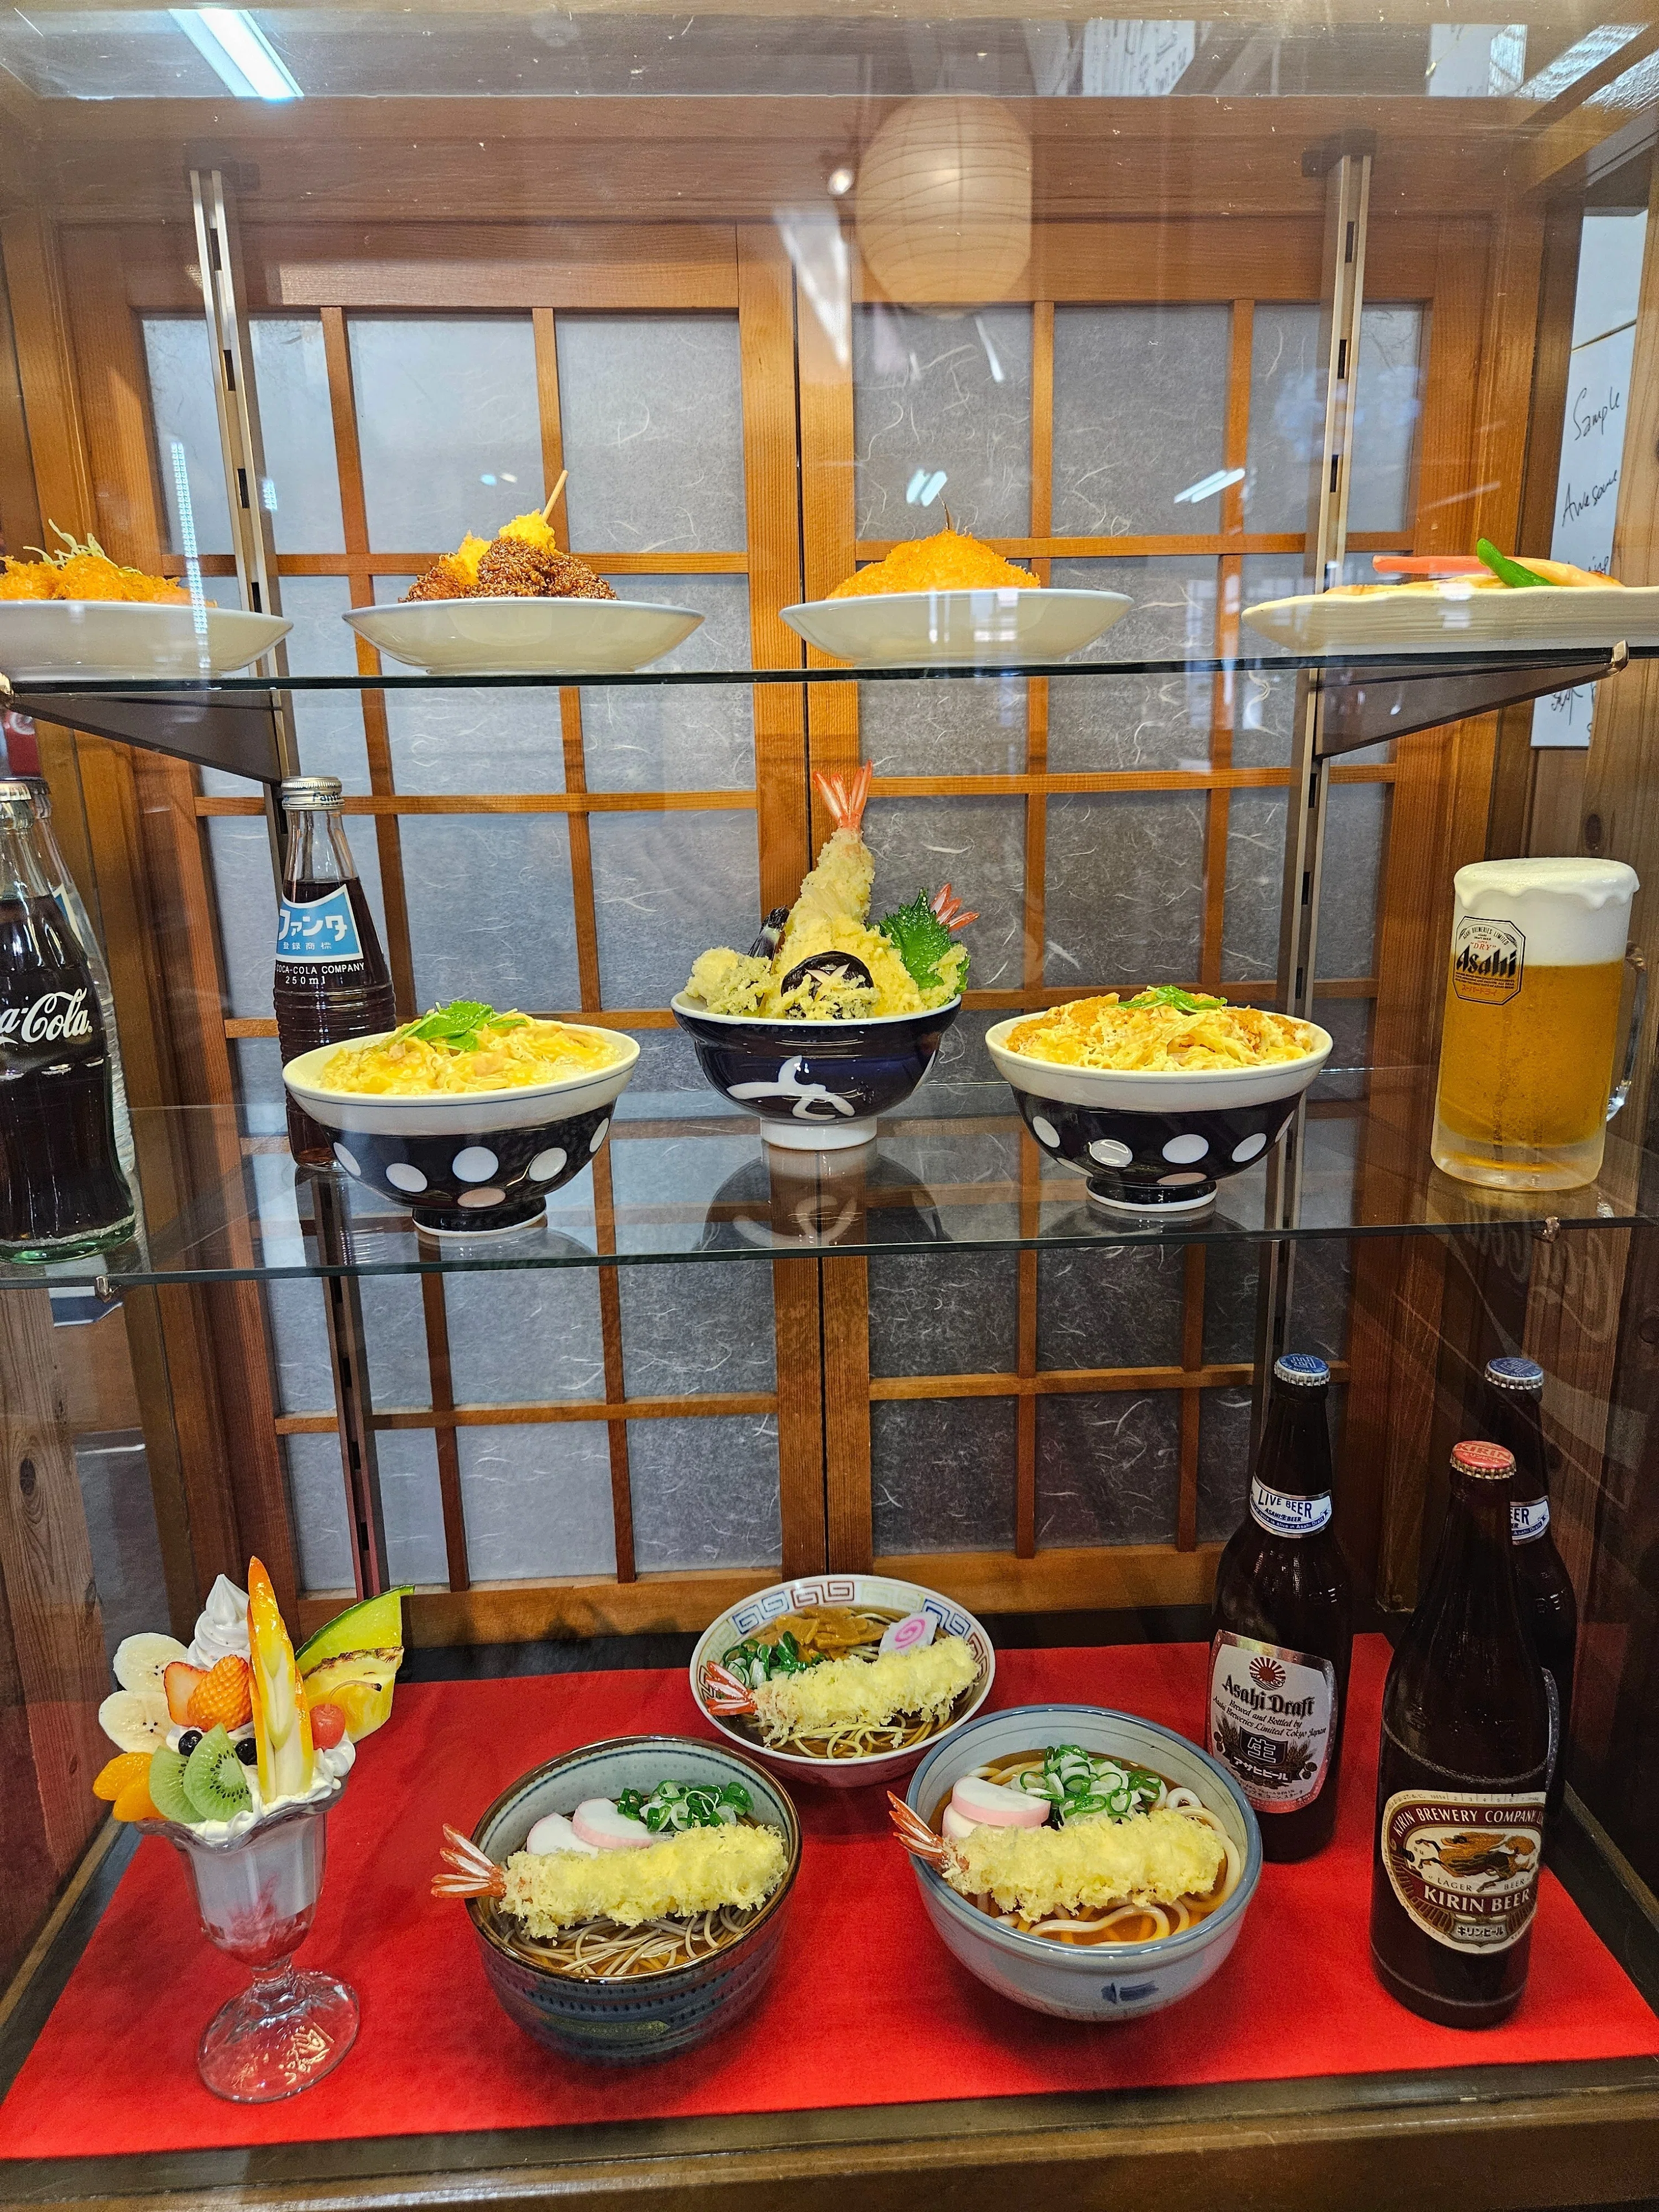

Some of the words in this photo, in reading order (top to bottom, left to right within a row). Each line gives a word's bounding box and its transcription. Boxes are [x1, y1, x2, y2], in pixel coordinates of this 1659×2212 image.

[278, 908, 348, 942] ファンタ
[1494, 931, 1509, 946] LIMITED
[283, 942, 332, 951] 登録商標
[321, 962, 365, 974] COMPANY
[1456, 945, 1517, 978] Asahi
[0, 987, 88, 1045] a-Cola
[1455, 1443, 1511, 1460] KIRIN
[1258, 1489, 1282, 1506] LIVE
[1285, 1500, 1312, 1519] BEER
[1222, 1674, 1266, 1710] Asahi
[1266, 1694, 1316, 1719] Draft
[1213, 1695, 1227, 1712] Asahi
[1226, 1707, 1254, 1728] Breweries
[1254, 1723, 1285, 1736] Limited
[1286, 1729, 1307, 1739] Tokyo
[1307, 1727, 1326, 1738] Japan
[1229, 1699, 1251, 1717] Brewed
[1253, 1713, 1266, 1723] and
[1267, 1716, 1293, 1729] Bottled
[1293, 1720, 1302, 1730] by
[1247, 1737, 1276, 1764] 生
[1233, 1756, 1288, 1781] アサヒビール
[1393, 1810, 1416, 1837] KIRIN
[1416, 1808, 1478, 1823] BREWERY
[1485, 1809, 1536, 1823] COMPANY
[1438, 1877, 1473, 1892] LAGER
[1504, 1879, 1525, 1890] BEER
[1424, 1885, 1484, 1912] KIRIN
[1491, 1888, 1530, 1912] BEER
[1457, 1926, 1504, 1937] キリンビール
